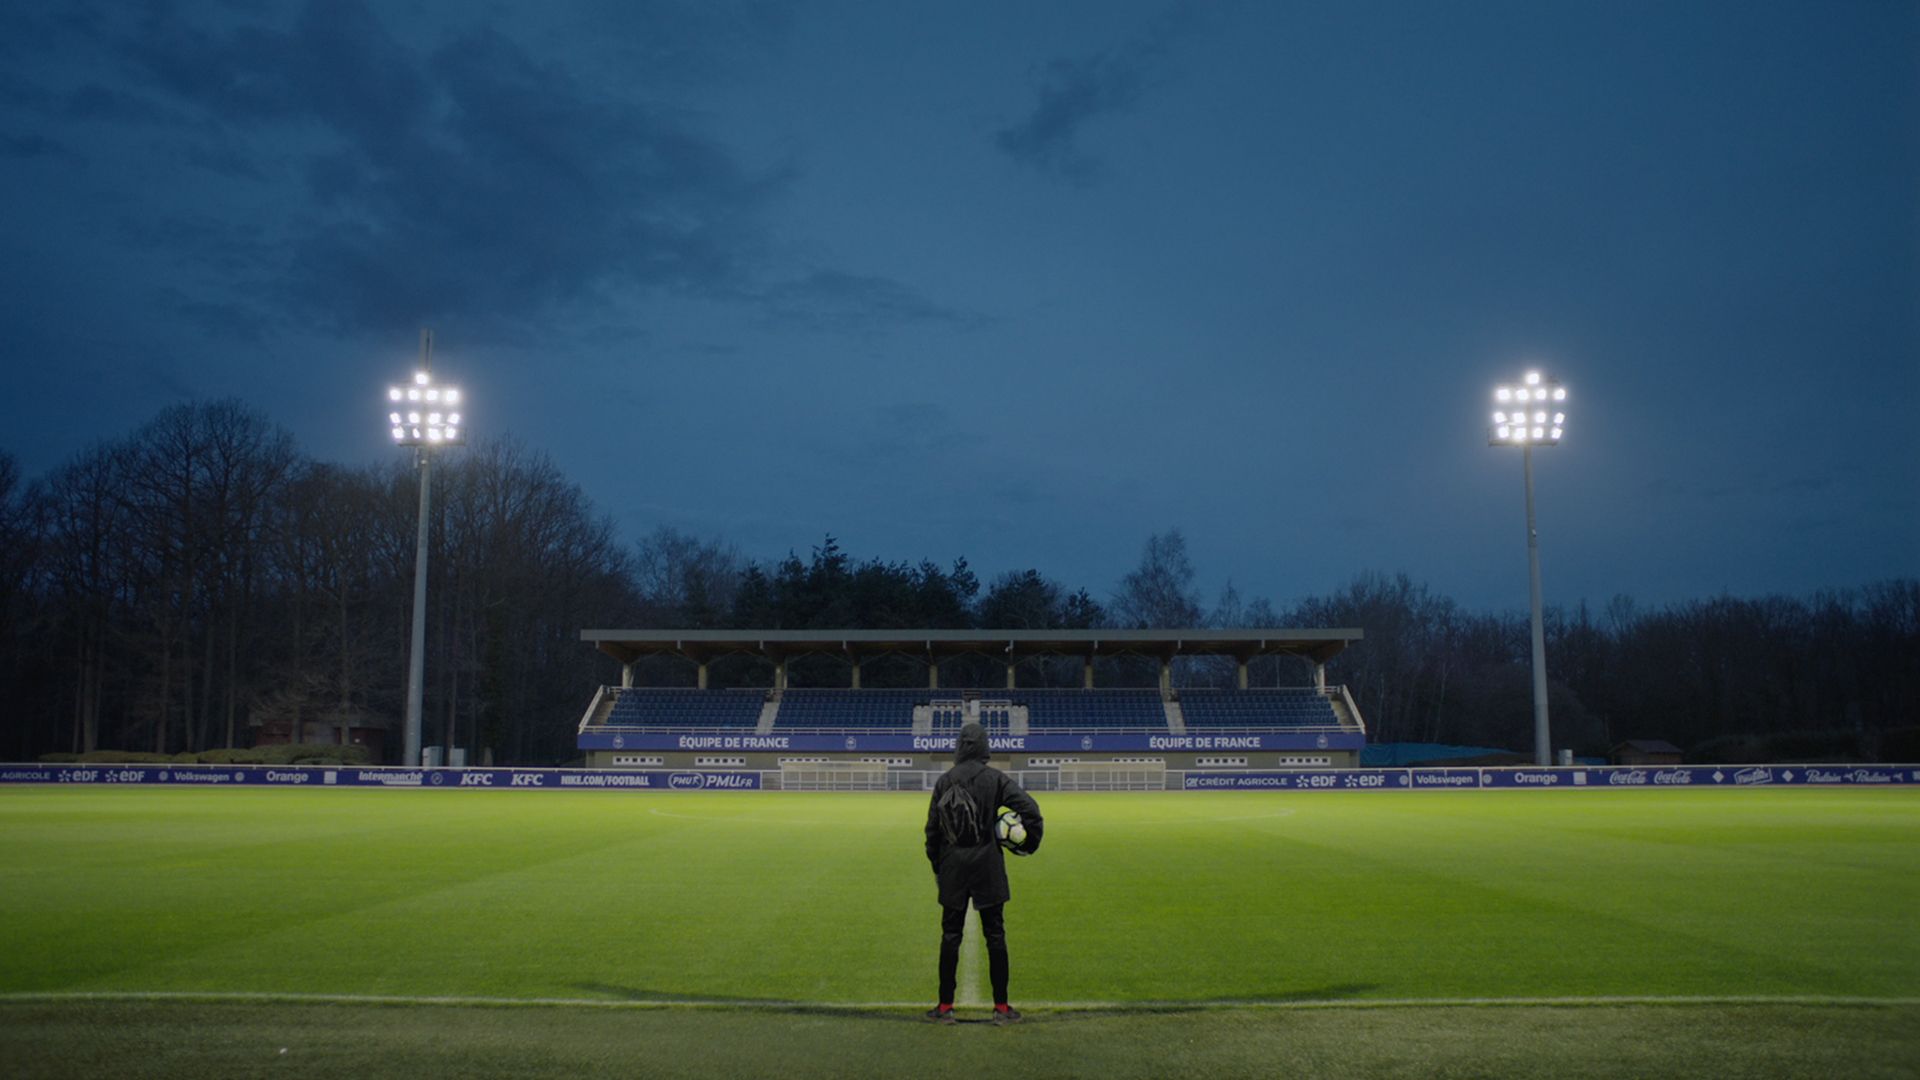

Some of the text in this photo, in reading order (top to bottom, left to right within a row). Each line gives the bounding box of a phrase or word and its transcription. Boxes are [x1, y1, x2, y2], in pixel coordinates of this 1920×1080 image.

[679, 736, 789, 749] ÉQUIPE DE FRANCE
[913, 737, 1025, 750] ÉQUIPE RANCE
[1150, 736, 1260, 749] ÉQUIPE DE FRANCE
[1, 771, 50, 780] AGRICOLE
[175, 771, 230, 784] Volkswagen
[266, 771, 309, 784] Orange
[461, 773, 494, 786] KFC
[511, 773, 544, 786] KFC
[560, 775, 650, 786] NIKE.COM/FOOTBALL
[1199, 776, 1235, 786] CRÉDIT
[1237, 777, 1287, 786] AGRICOLE
[1416, 774, 1473, 785] Volkswagen
[1515, 772, 1558, 785] Orange
